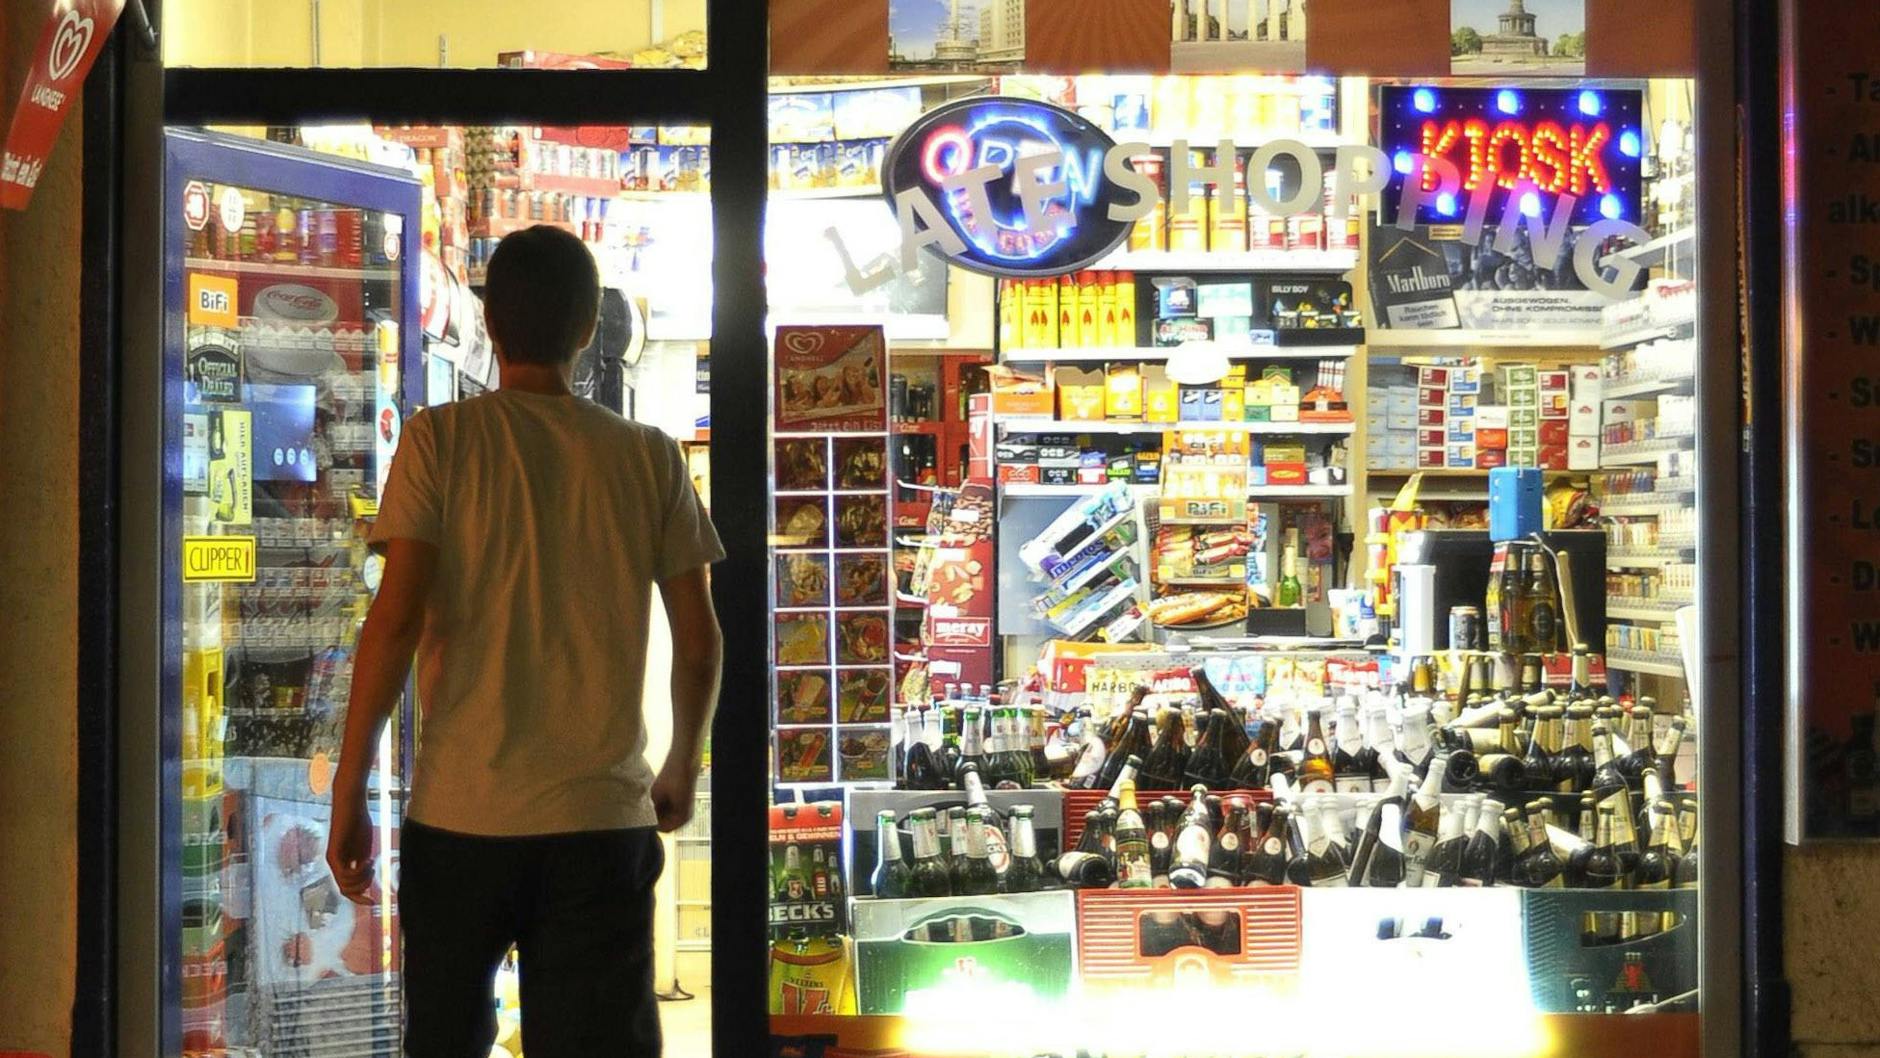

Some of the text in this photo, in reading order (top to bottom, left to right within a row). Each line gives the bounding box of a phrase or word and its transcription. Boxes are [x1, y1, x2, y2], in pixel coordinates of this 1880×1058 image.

[1421, 119, 1611, 195] KIOSK
[824, 150, 1078, 298] LATE
[1103, 139, 1651, 300] SHOPPING
[1271, 285, 1308, 293] BILLY BOY
[1387, 266, 1451, 293] Marlboro
[200, 291, 228, 312] BiFi
[189, 546, 242, 572] CLIPPER
